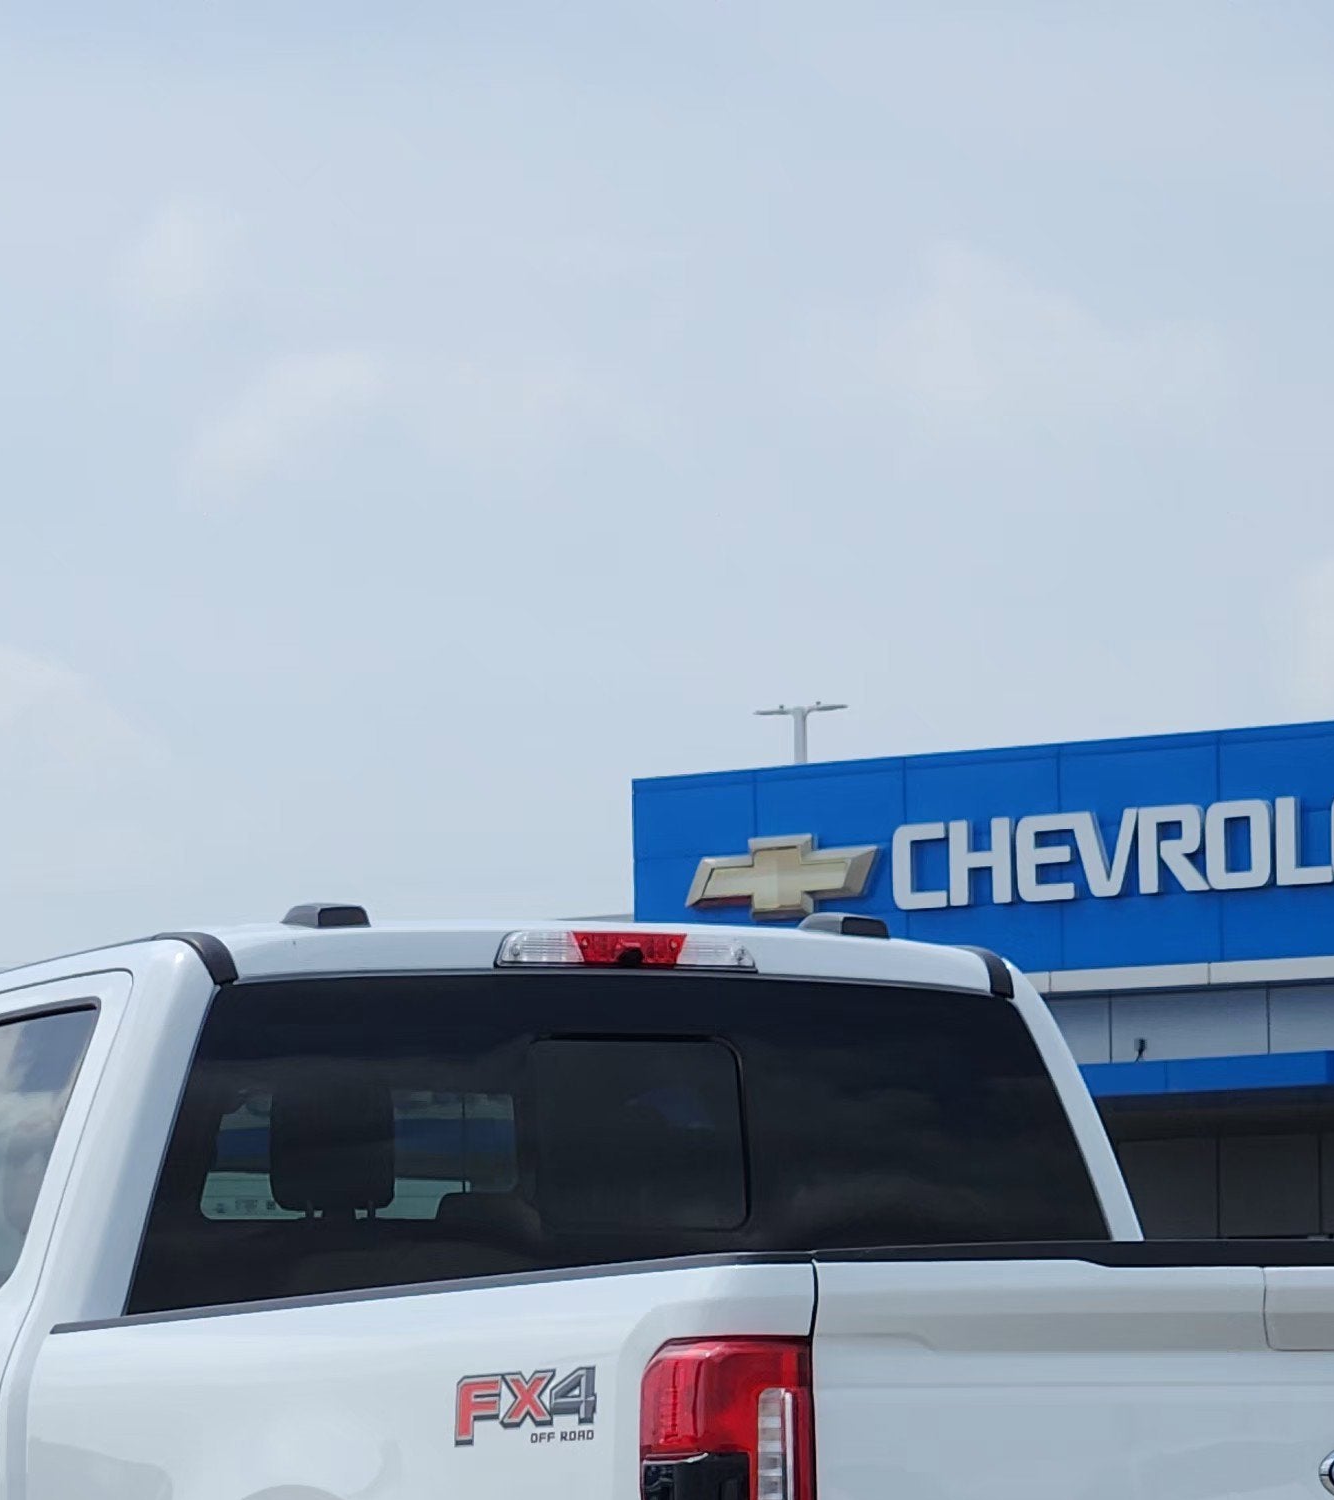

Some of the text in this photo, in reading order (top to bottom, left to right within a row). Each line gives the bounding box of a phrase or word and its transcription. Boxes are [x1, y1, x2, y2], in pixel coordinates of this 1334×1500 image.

[455, 1366, 597, 1446] FX4
[530, 1430, 594, 1444] OFF ROAD
